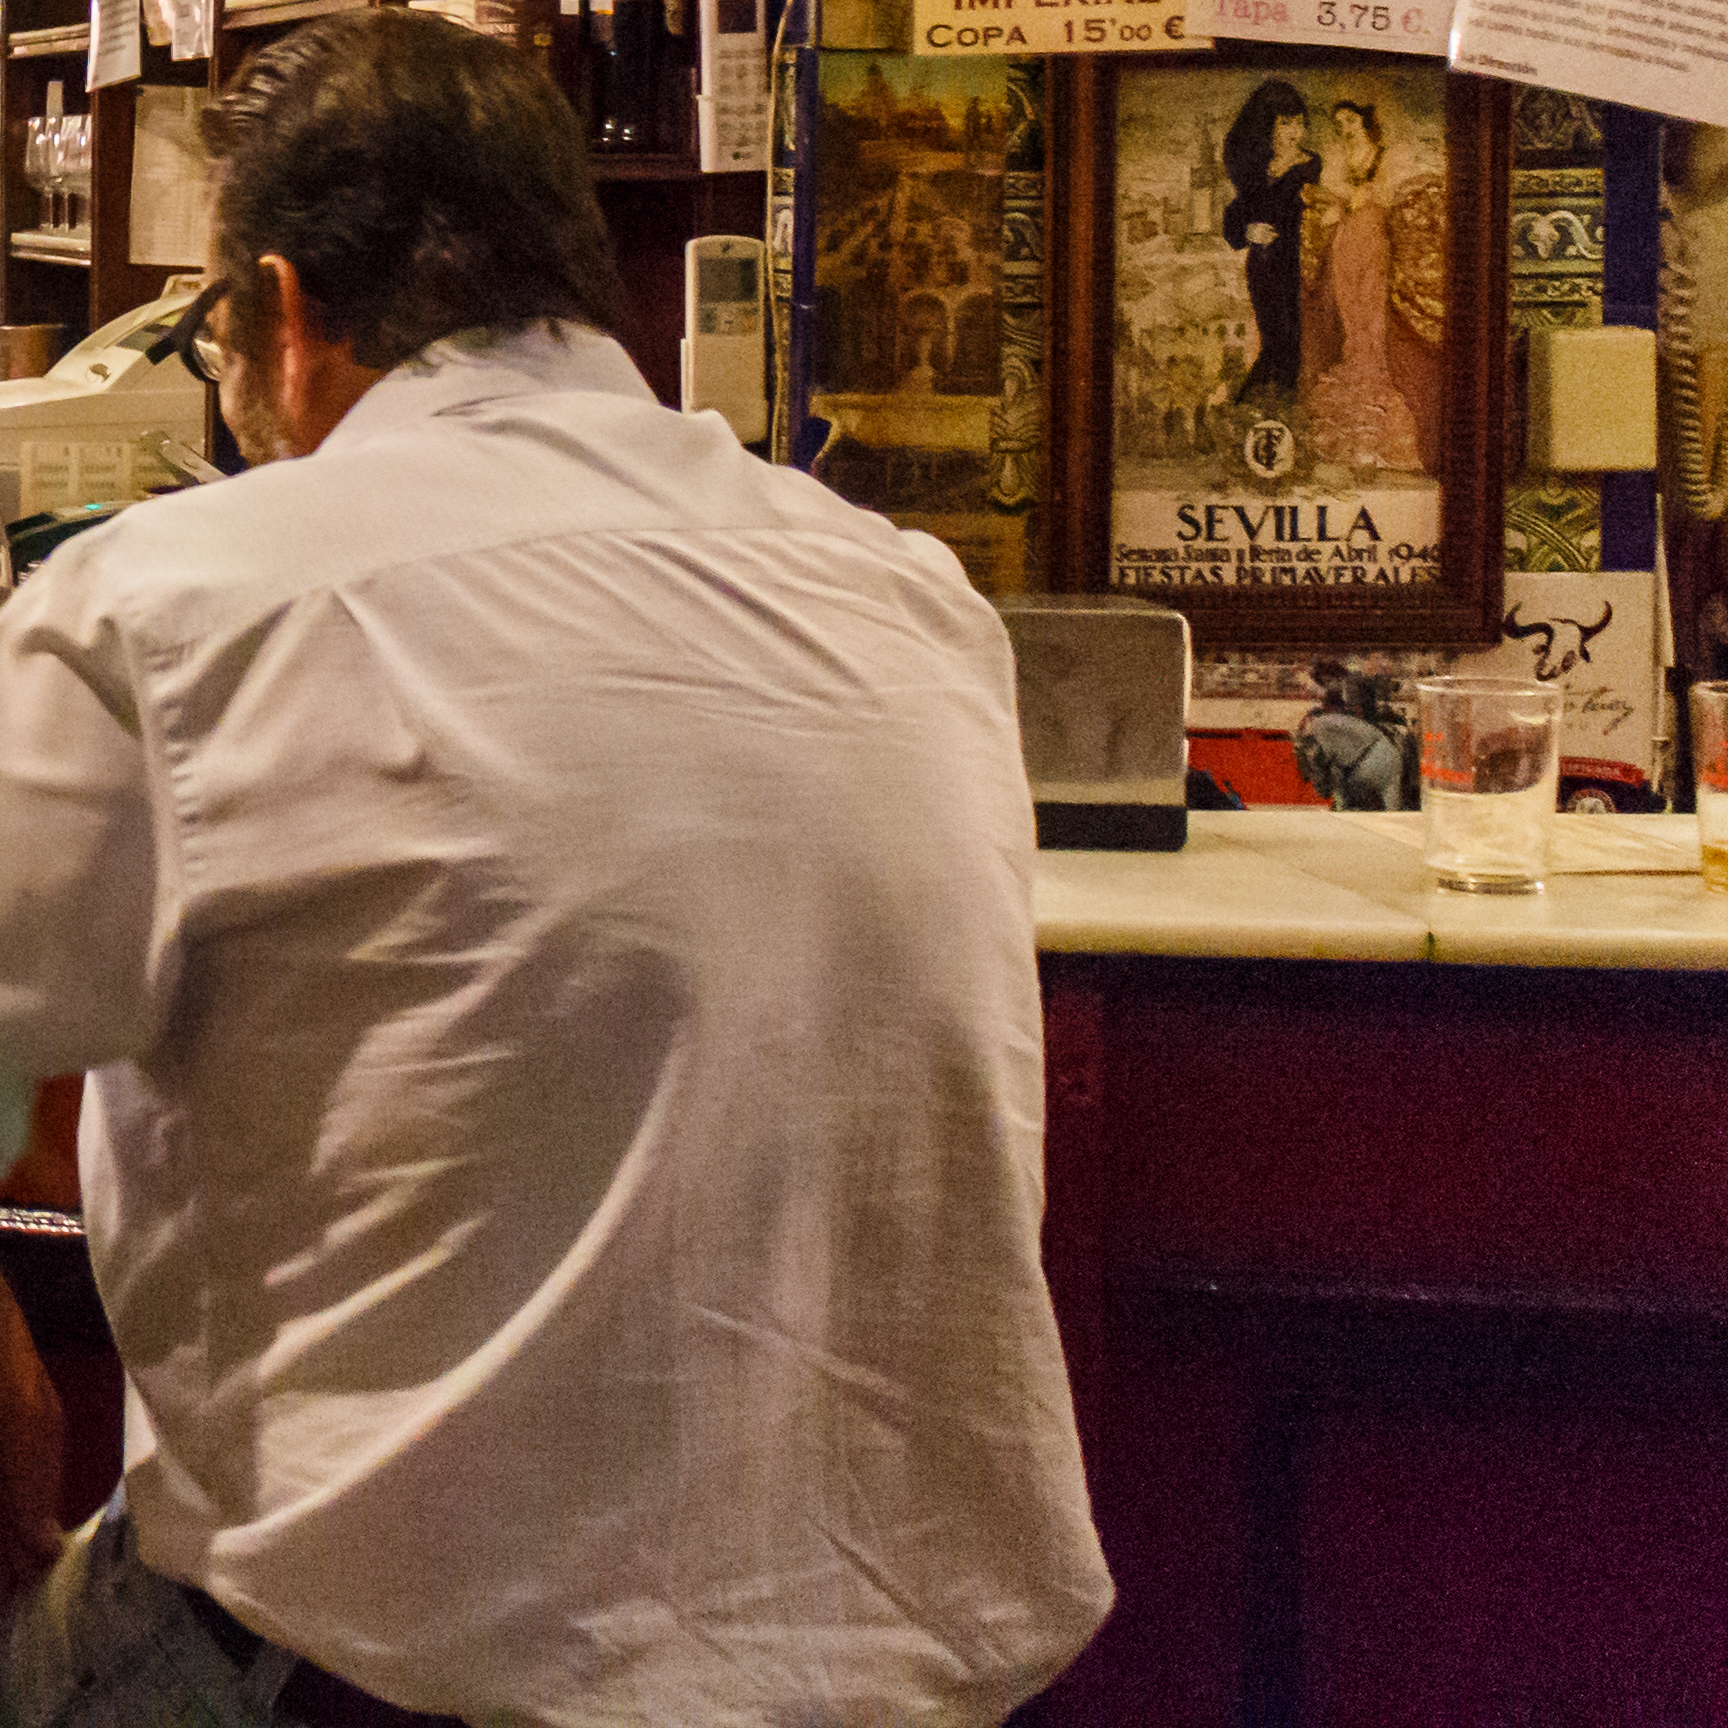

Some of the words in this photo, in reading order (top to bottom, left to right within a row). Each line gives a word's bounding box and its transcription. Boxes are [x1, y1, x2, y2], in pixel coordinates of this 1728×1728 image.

[925, 23, 1028, 49] COPA
[1164, 14, 1185, 41] €
[1317, 0, 1392, 32] 3,75
[1176, 503, 1384, 543] SEVILLA
[1115, 543, 1180, 564] Semana
[1182, 543, 1231, 564] Santa
[1250, 543, 1293, 564] Feria
[1295, 544, 1323, 564] de
[1331, 542, 1378, 563] Abril
[1114, 565, 1225, 586] FIESTAS
[1235, 564, 1441, 586] PRIMAVERALES
